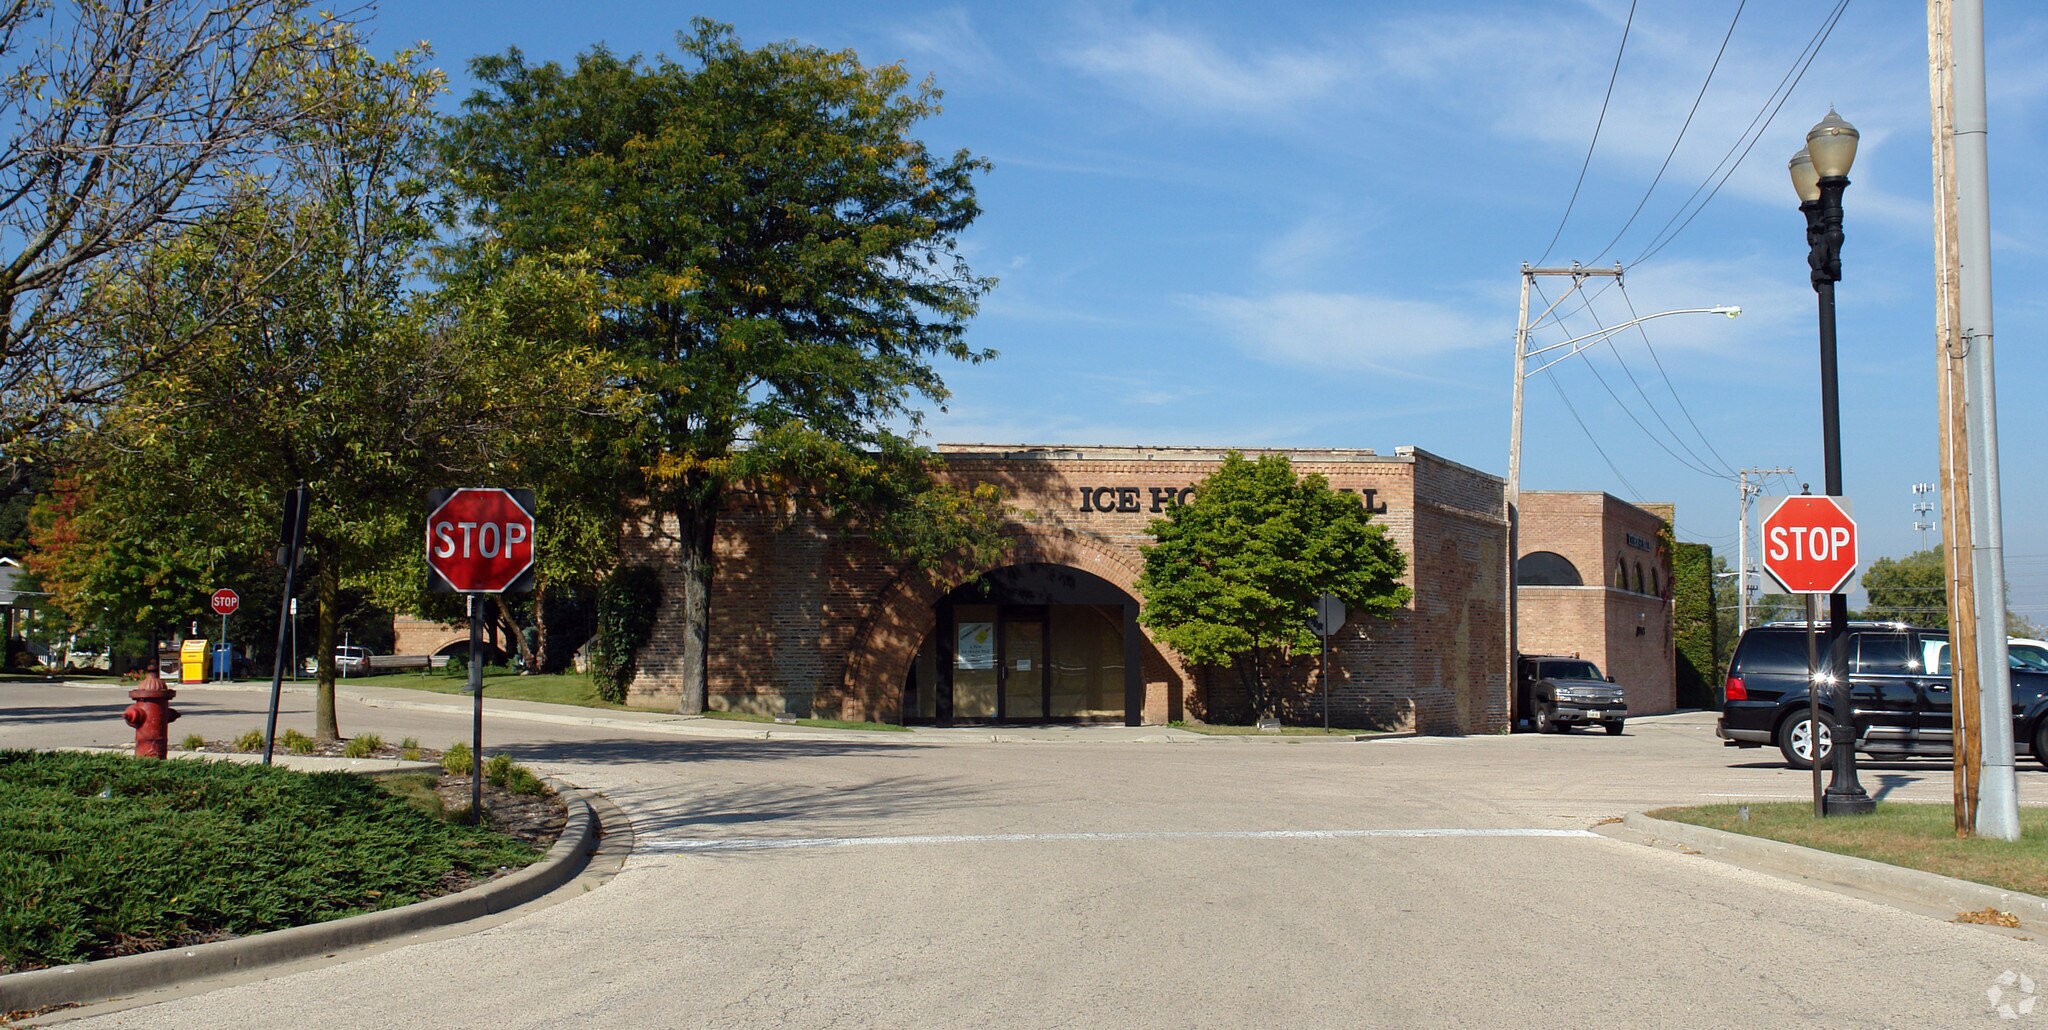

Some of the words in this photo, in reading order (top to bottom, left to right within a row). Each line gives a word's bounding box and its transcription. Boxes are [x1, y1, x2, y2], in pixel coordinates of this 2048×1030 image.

[1080, 486, 1141, 512] ICE
[434, 521, 526, 558] STOP
[1769, 526, 1851, 562] STOP
[213, 596, 238, 607] STOP
